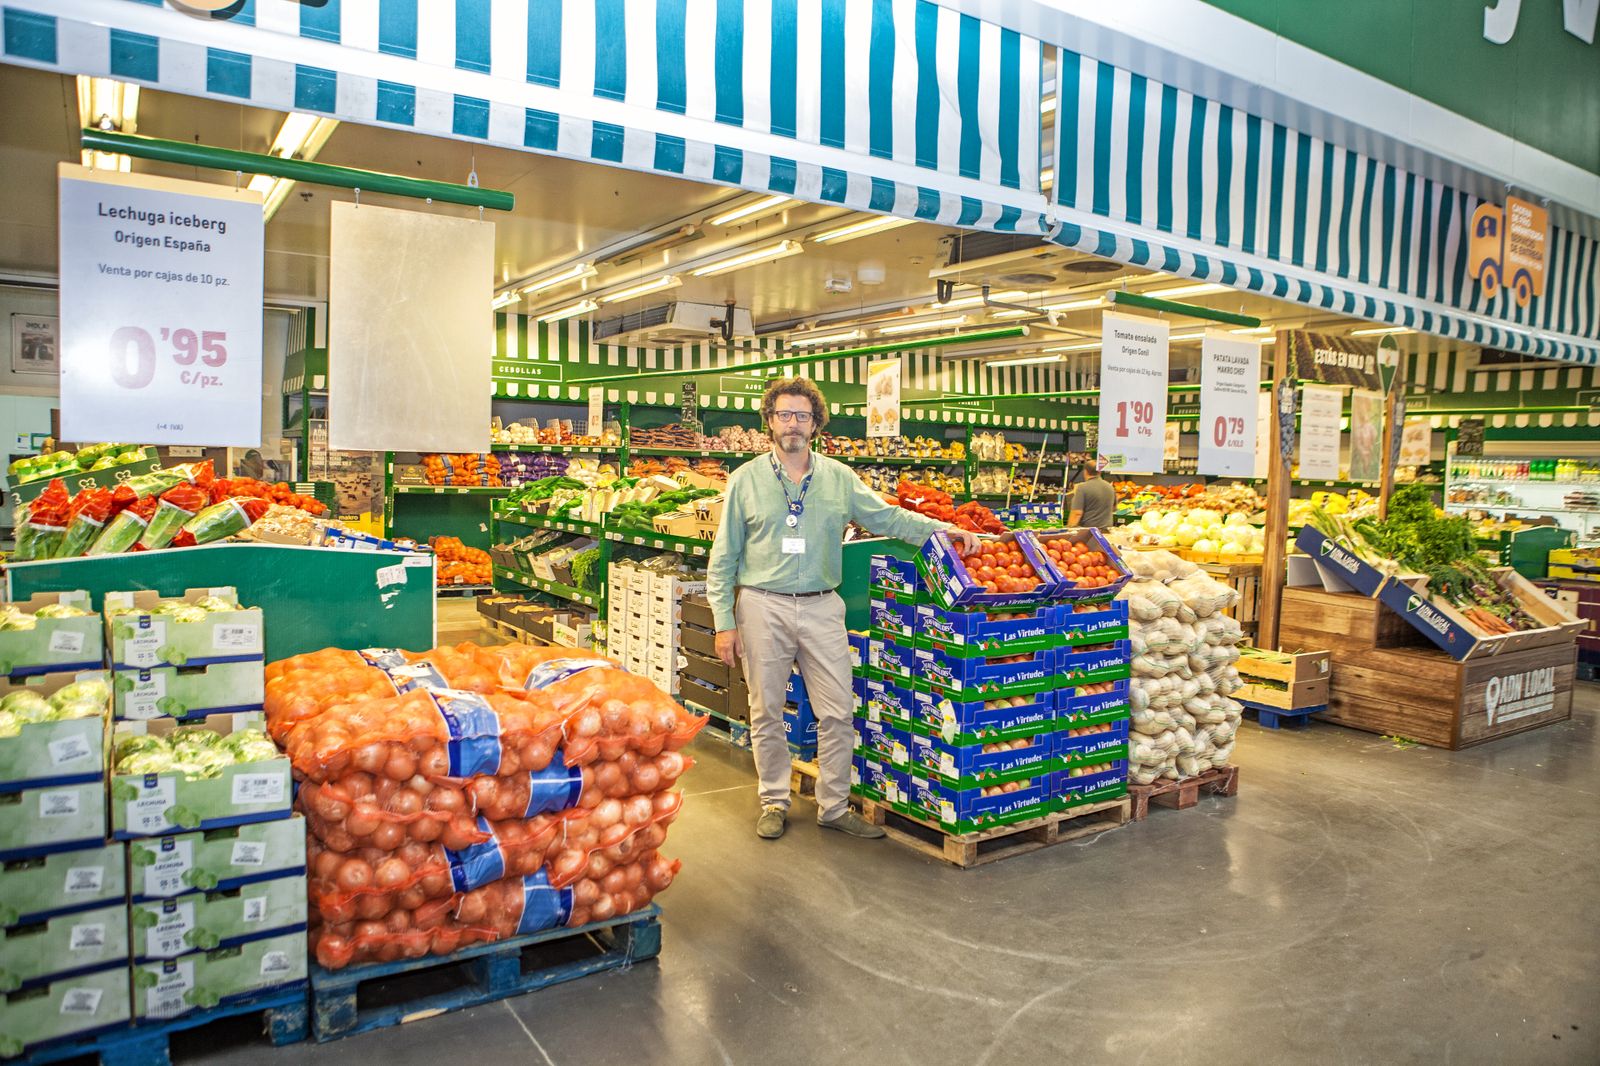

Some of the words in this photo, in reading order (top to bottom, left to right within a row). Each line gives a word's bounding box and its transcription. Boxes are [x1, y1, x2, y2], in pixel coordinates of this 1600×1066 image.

[97, 202, 165, 226] Lechuga
[169, 211, 227, 235] iceberg
[114, 230, 160, 248] Origen
[164, 235, 211, 253] España
[98, 263, 131, 276] Venta
[134, 269, 152, 280] por
[155, 271, 183, 283] cajas
[186, 272, 198, 283] de
[201, 274, 212, 285] 10
[215, 277, 230, 287] pz.
[1114, 329, 1133, 341] Tomate
[1135, 334, 1157, 344] ensalada
[1121, 345, 1138, 356] Origen
[1138, 348, 1150, 357] Conil
[1314, 346, 1337, 367] ESTÁS
[1338, 351, 1348, 368] EN
[1213, 353, 1231, 363] PATATA
[1231, 356, 1249, 365] LAVADA
[499, 365, 542, 376] CEBOLLAS
[1217, 366, 1233, 375] MAKRO
[1233, 367, 1245, 375] CHEF
[180, 370, 223, 389] €/pz.
[1087, 623, 1097, 632] Las
[1098, 619, 1121, 630] Virtudes
[1004, 632, 1016, 642] Las
[1017, 627, 1045, 638] Virtudes
[1087, 663, 1098, 671] Las
[1099, 658, 1123, 669] Virtudes
[1003, 675, 1015, 685] Las
[1016, 670, 1044, 682] Virtudes
[1499, 673, 1523, 704] ADN
[1524, 667, 1556, 698] LOCAL
[1090, 704, 1102, 713] Las
[1102, 699, 1124, 710] Virtudes
[1002, 719, 1015, 729] Las
[1016, 713, 1044, 725] Virtudes
[1085, 744, 1096, 753] Las
[1097, 739, 1121, 750] Virtudes
[1001, 761, 1013, 771] Las
[1015, 754, 1042, 767] Virtudes
[1085, 783, 1096, 793] Las
[1096, 777, 1120, 789] Virtudes
[137, 800, 166, 808] LECHUGA
[999, 804, 1012, 815] Las
[1013, 796, 1040, 809] Virtudes
[155, 861, 184, 871] LECHUGA
[157, 922, 186, 933] LECHUGA
[157, 982, 186, 993] LECHUGA
